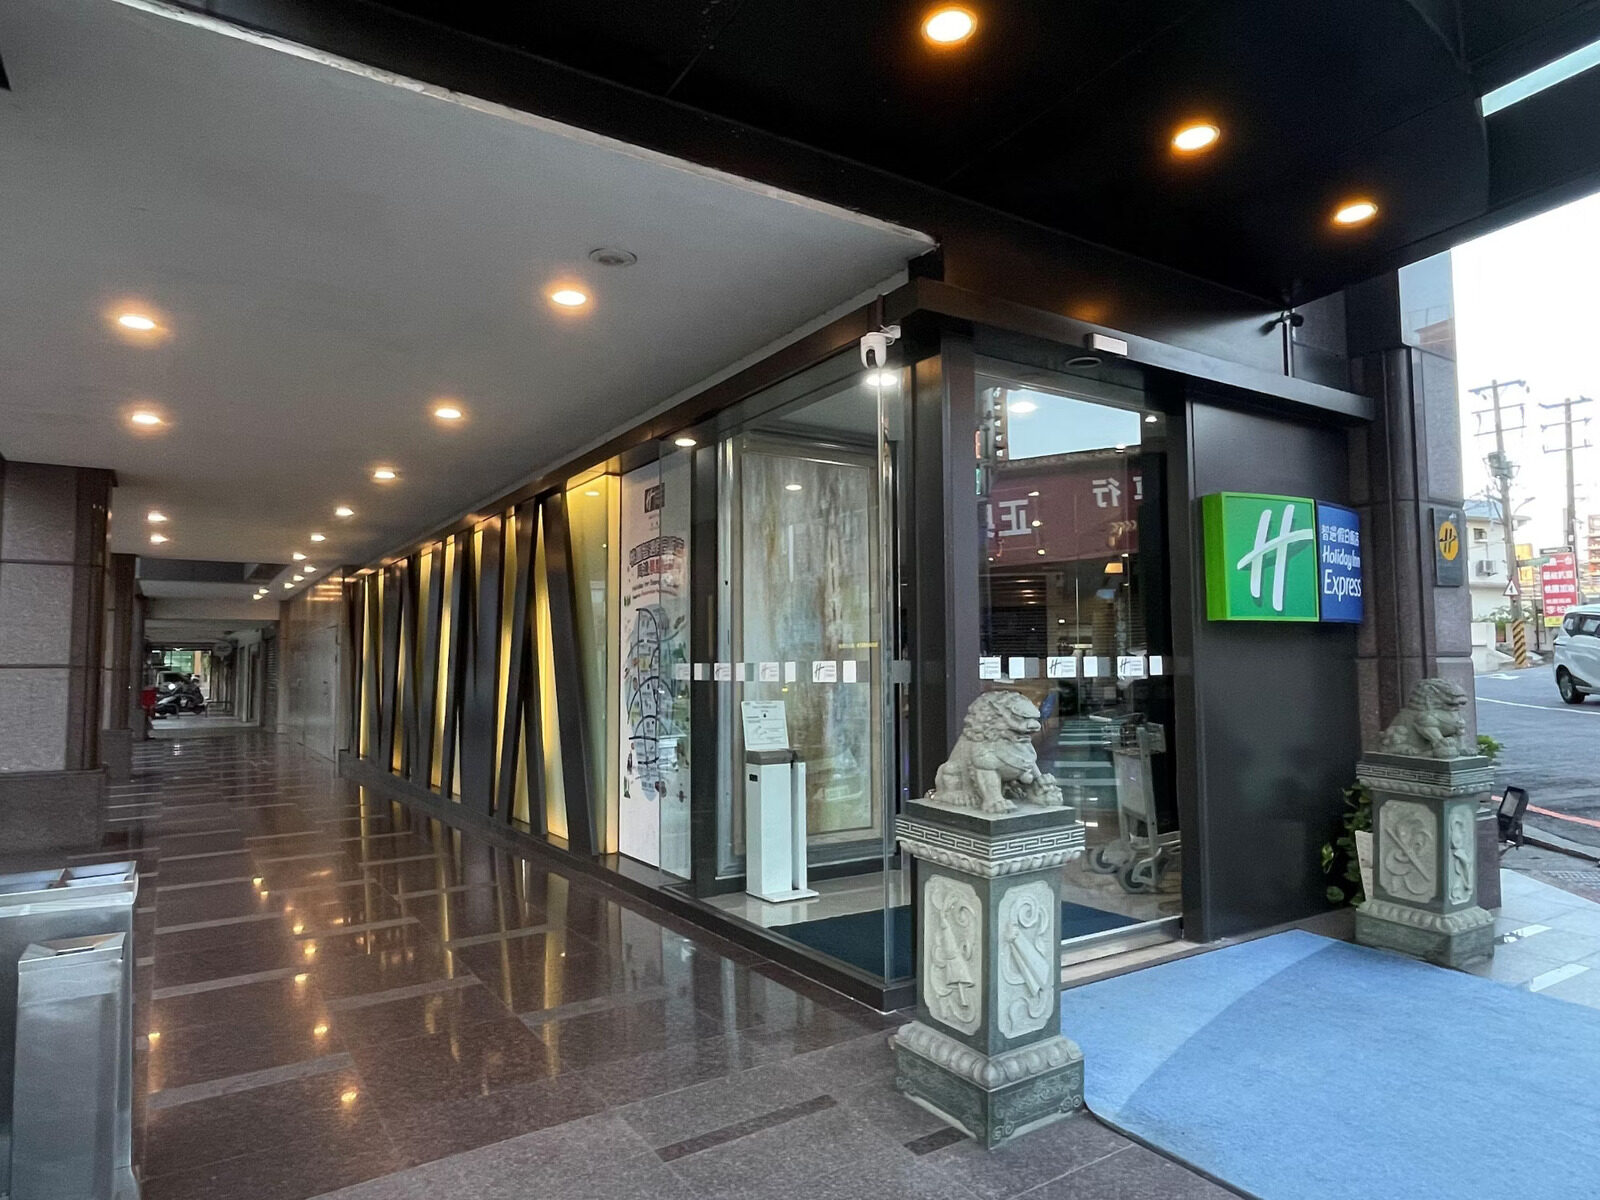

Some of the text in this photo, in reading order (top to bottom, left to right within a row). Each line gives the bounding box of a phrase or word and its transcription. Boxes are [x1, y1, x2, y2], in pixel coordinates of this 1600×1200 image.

[1323, 545, 1360, 570] Holiday Inn
[1324, 569, 1361, 602] Express
